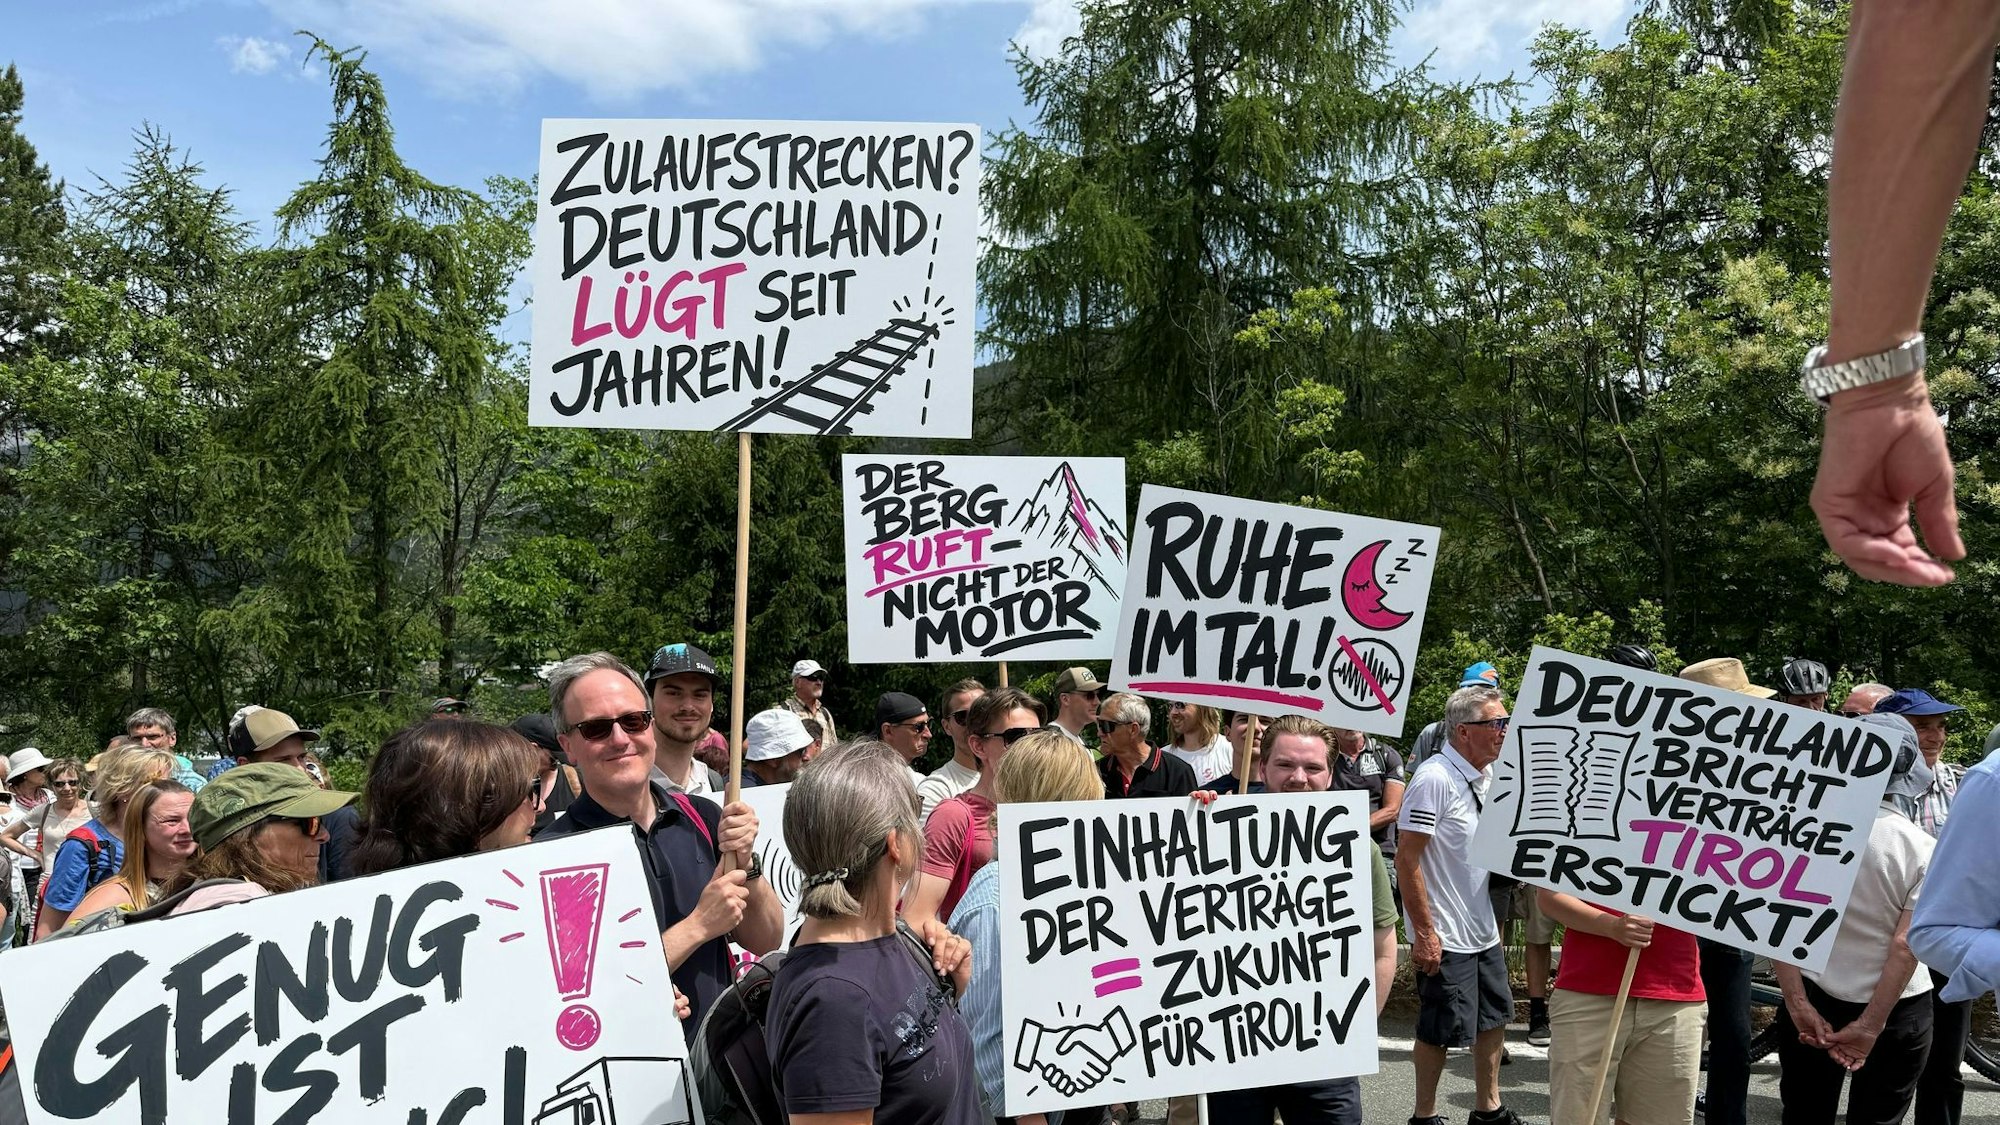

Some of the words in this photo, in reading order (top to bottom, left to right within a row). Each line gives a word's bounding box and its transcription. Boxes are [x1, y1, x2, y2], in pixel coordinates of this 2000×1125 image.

[550, 130, 974, 206] ZULAUFSTRECKEN?
[558, 199, 928, 281] DEUTSCHLAND
[571, 262, 748, 347] LÜGT
[754, 269, 857, 323] SEIT
[549, 325, 790, 417] JAHREN!
[855, 460, 954, 503] DER
[861, 483, 1009, 546] BERG
[883, 566, 1010, 629] NICHT
[1013, 556, 1070, 588] DER
[1144, 501, 1344, 611] RUHE
[914, 580, 1102, 660] MOTOR
[1128, 607, 1198, 679] IM
[1204, 611, 1337, 691] TAL!
[1533, 660, 1894, 779] DEUTSCHLAND
[1649, 737, 1848, 811] BRICHT
[1019, 804, 1360, 901] EINHALTUNG
[1628, 819, 1834, 906] TIROL
[1646, 778, 1855, 865] VERTRÄGE,
[1020, 895, 1128, 965] DER
[1138, 871, 1355, 946] VERTRÄGE
[1510, 838, 1840, 962] ERSTICKT!
[33, 880, 481, 1125] GENUG
[1152, 925, 1362, 1010] ZUKUNFT
[227, 993, 427, 1125] IST
[1138, 1012, 1216, 1079] FÜR
